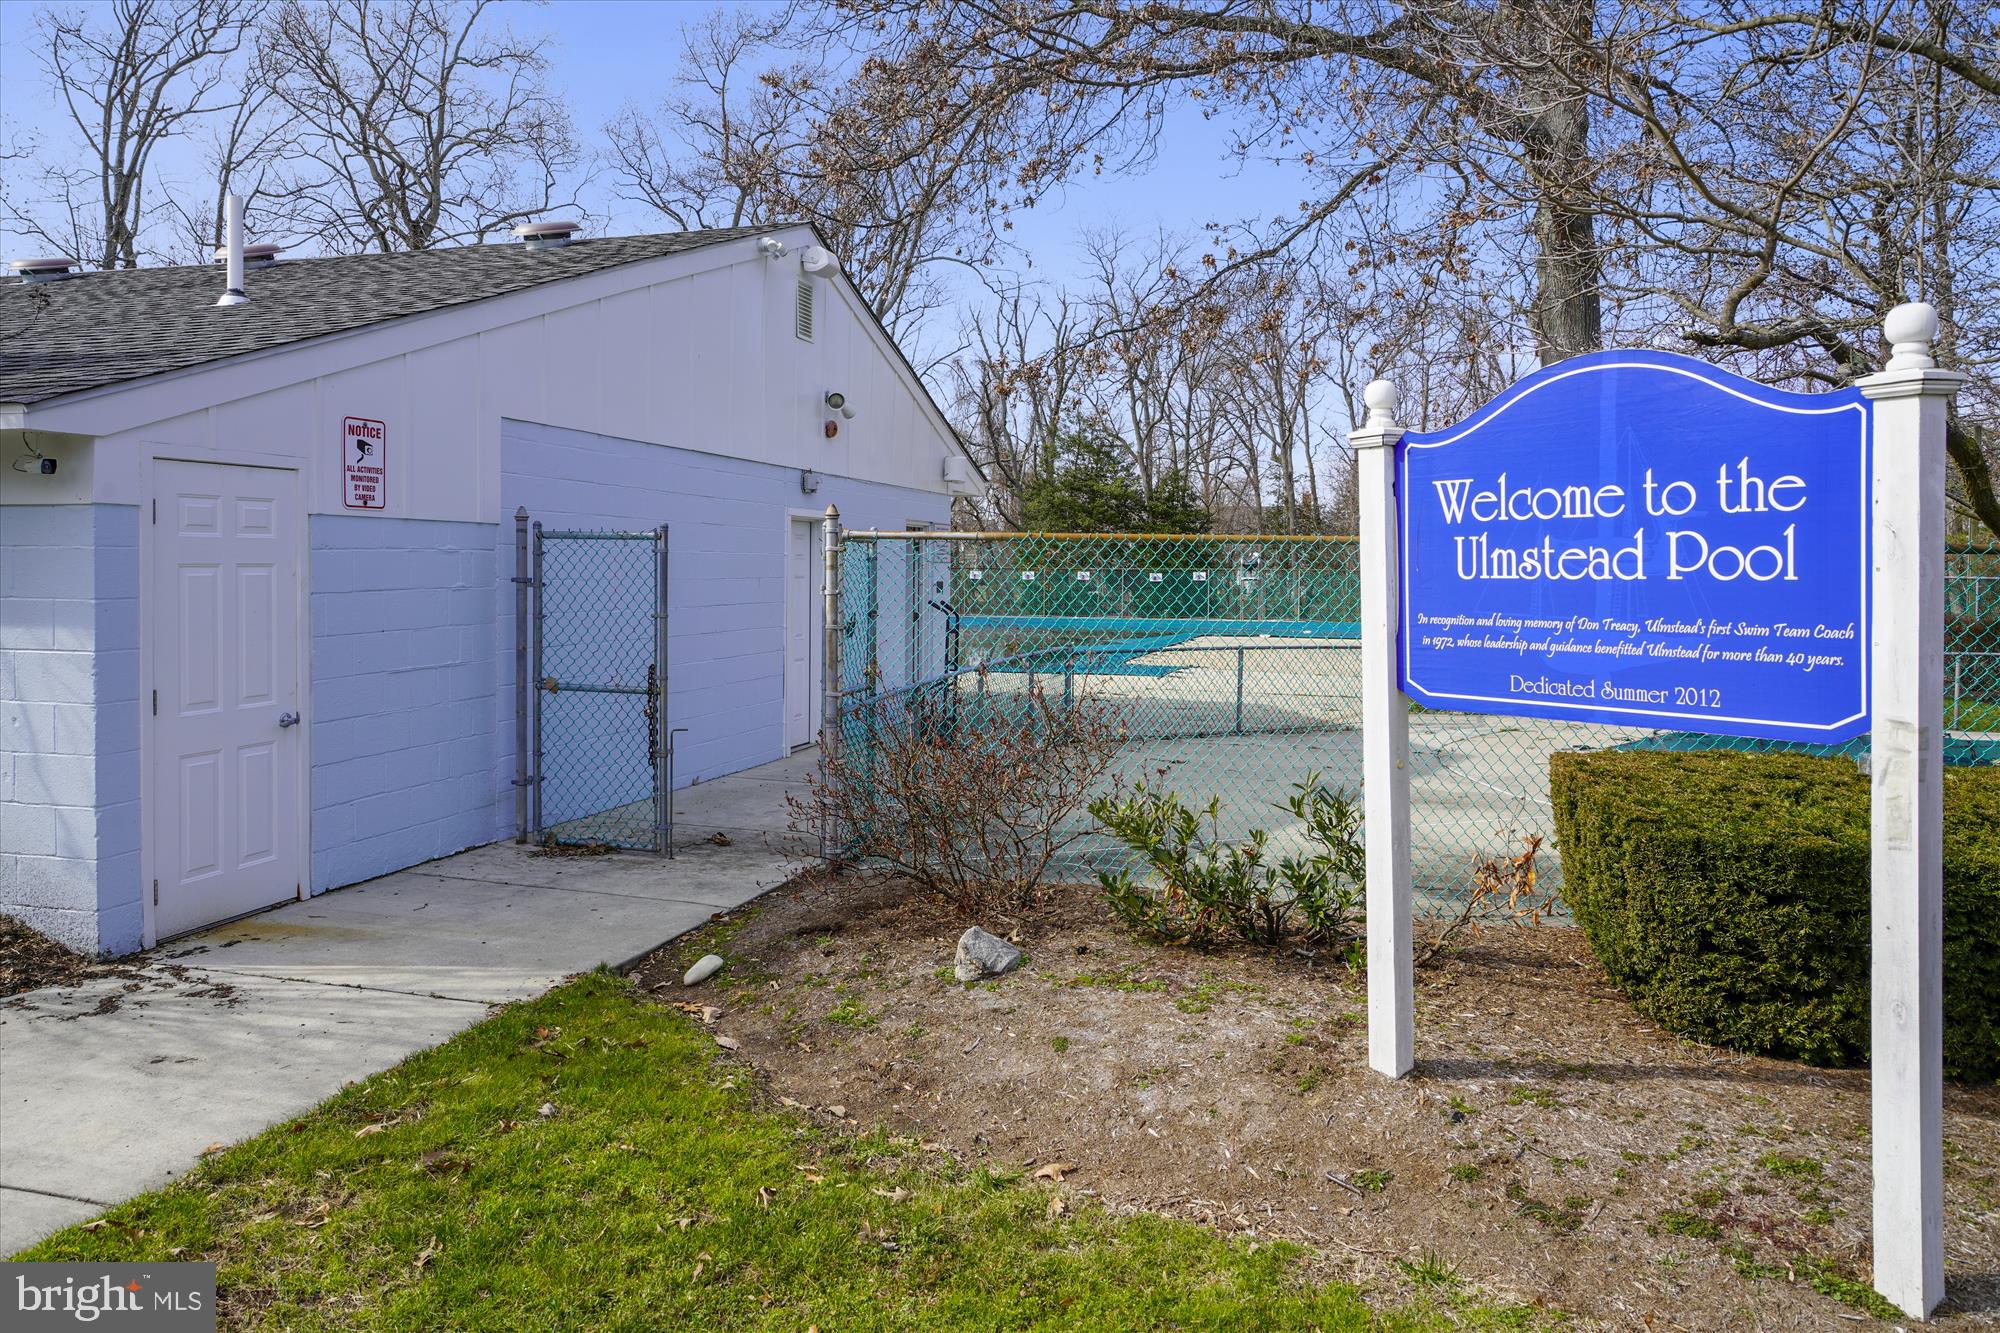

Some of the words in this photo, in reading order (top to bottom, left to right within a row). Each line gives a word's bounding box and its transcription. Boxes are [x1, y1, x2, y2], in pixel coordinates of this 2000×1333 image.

[348, 424, 382, 439] NOTICE
[346, 465, 355, 473] ALL
[356, 466, 383, 475] ACTIVITIES
[350, 475, 379, 484] MONITORED
[354, 494, 375, 502] CAMERA
[361, 485, 376, 493] VIDEO
[1432, 471, 1626, 525] Welcome
[1642, 467, 1697, 517] to
[1715, 456, 1807, 514] the
[1453, 527, 1648, 581] Ulmstead
[1665, 522, 1799, 582] Pool
[1417, 612, 1429, 625] In
[1429, 614, 1475, 631] recognition
[1476, 612, 1497, 627] and
[1495, 612, 1523, 634] loving
[1524, 619, 1563, 636] memory
[1564, 615, 1578, 633] of
[1577, 617, 1600, 631] Don
[1602, 617, 1641, 639] Treacy,
[1644, 617, 1707, 635] Ulmstead's
[1706, 618, 1733, 639] first
[1733, 621, 1770, 637] Swim
[1773, 622, 1811, 638] Team
[1813, 622, 1855, 640] Coach
[1422, 635, 1431, 646] in
[1456, 633, 1483, 648] whose
[1483, 633, 1529, 657] leadership
[1528, 636, 1552, 651] and
[1547, 637, 1593, 658] guidance
[1594, 638, 1648, 659] benefitted
[1646, 641, 1704, 660] Ulmstead
[1701, 643, 1721, 663] for
[1721, 651, 1753, 662] more
[1754, 645, 1784, 664] than
[1785, 652, 1805, 667] 40
[1802, 655, 1845, 673] years.
[1510, 674, 1596, 698] Dedicated
[1600, 681, 1669, 705] Summer
[1674, 686, 1721, 708] 2012
